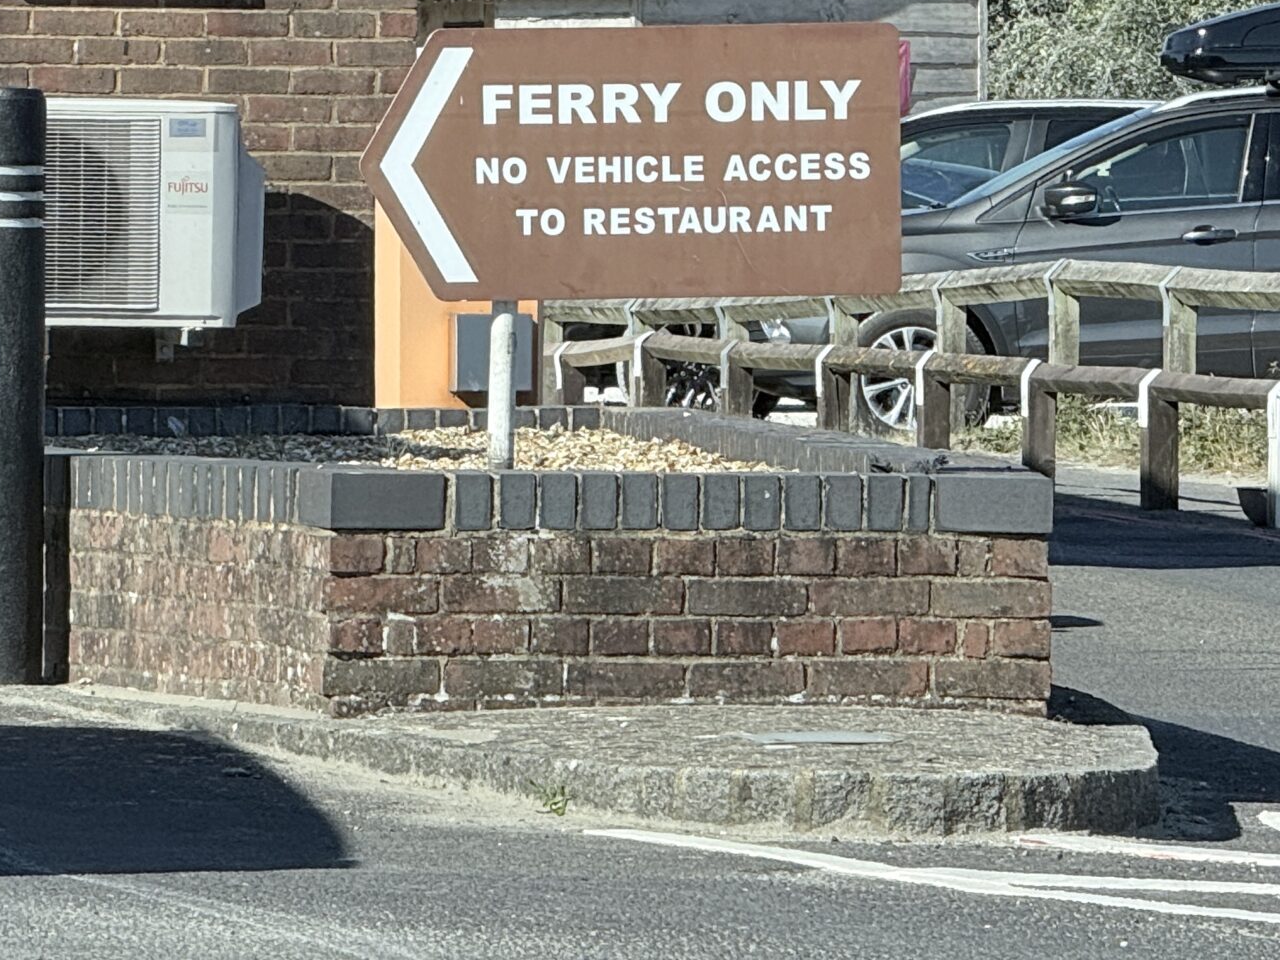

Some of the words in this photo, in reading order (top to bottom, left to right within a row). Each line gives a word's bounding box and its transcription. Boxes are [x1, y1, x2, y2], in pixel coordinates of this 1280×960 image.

[481, 82, 682, 125] FERRY
[704, 79, 862, 123] ONLY
[475, 157, 528, 185] NO
[546, 155, 705, 184] VEHICLE
[722, 152, 872, 182] ACCESS
[167, 176, 209, 195] FUJITSU
[515, 208, 566, 237] TO
[583, 204, 833, 236] RESTAURANT
